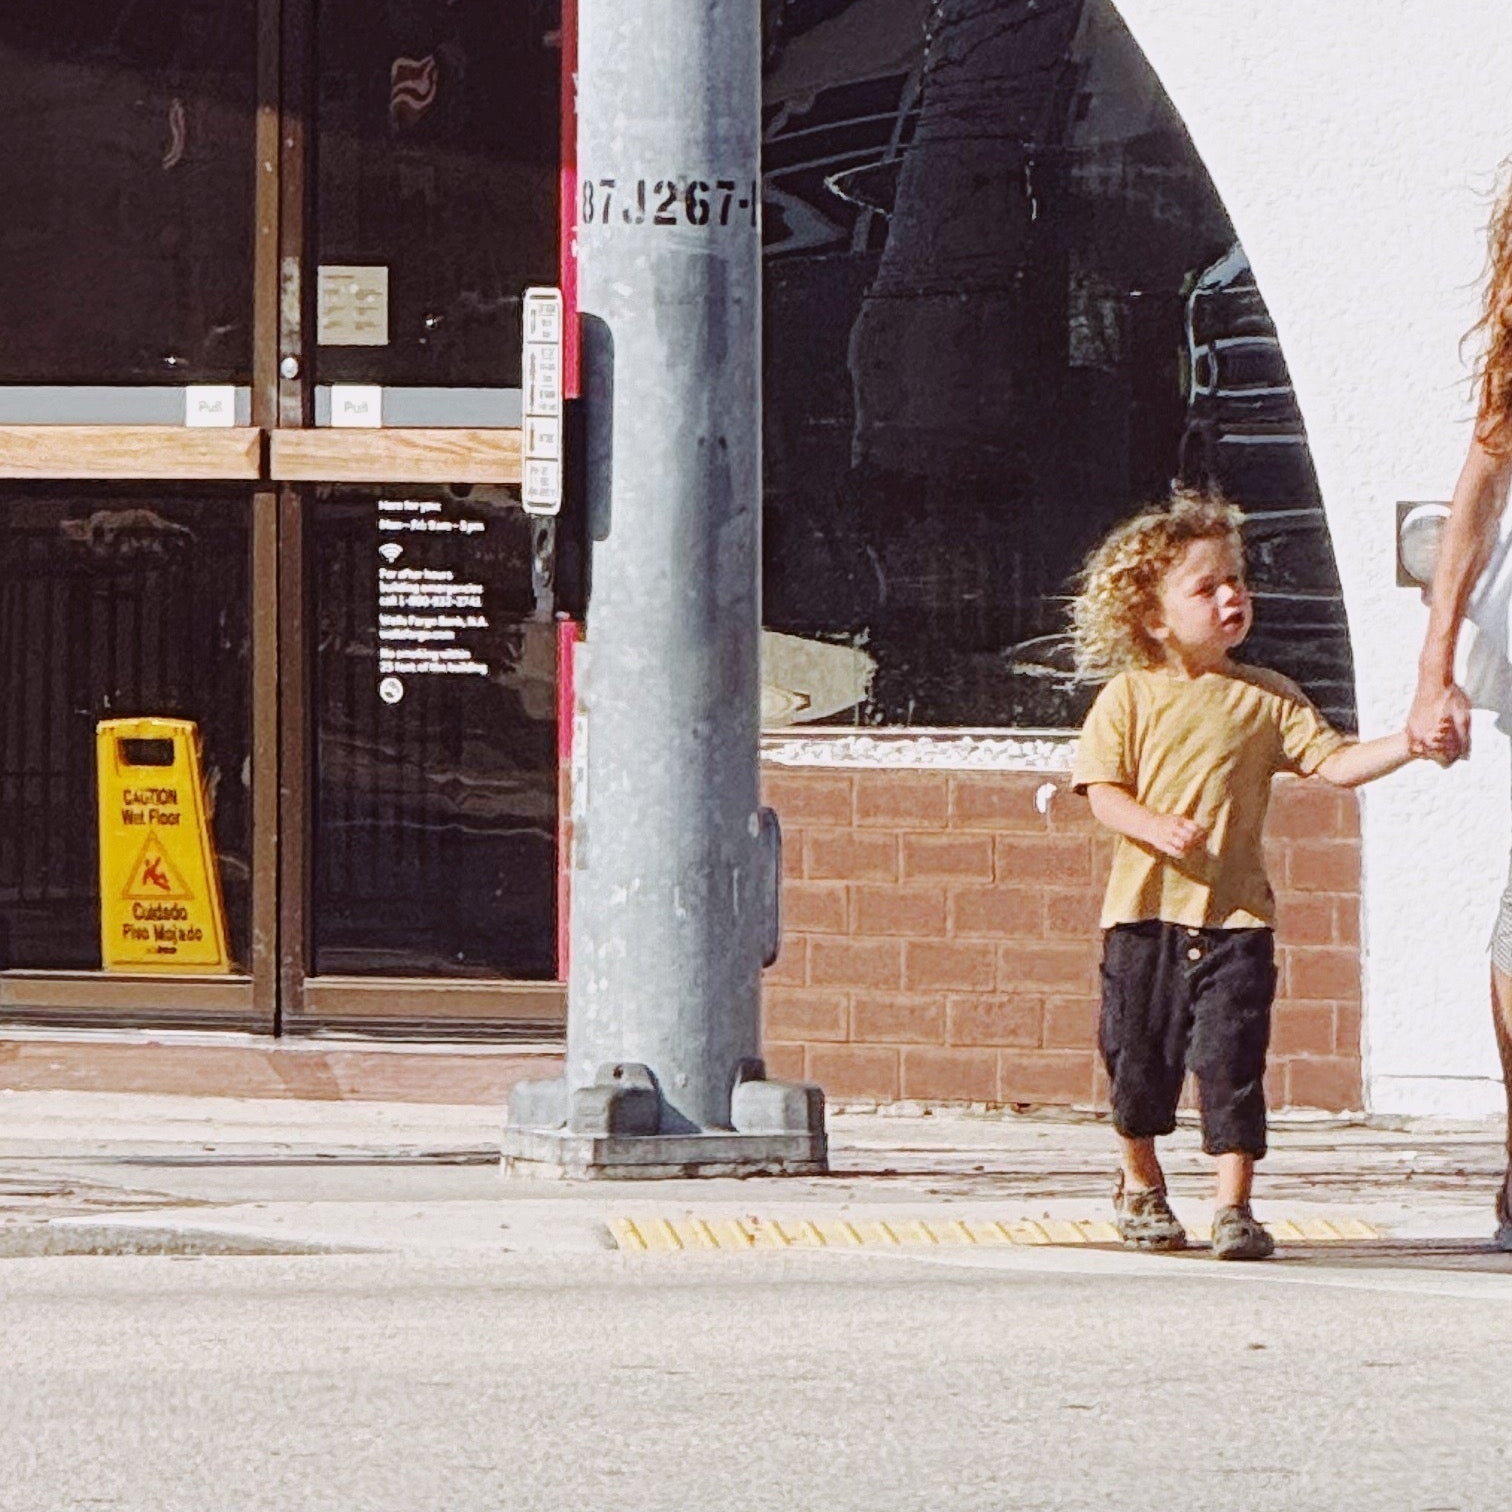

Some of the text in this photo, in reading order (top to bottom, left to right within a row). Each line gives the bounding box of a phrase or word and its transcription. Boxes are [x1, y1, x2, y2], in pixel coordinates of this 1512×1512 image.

[343, 399, 368, 414] Pull
[123, 788, 178, 806] CAUTION
[122, 808, 180, 826] Wet Floor
[132, 901, 188, 922] Cuidado
[122, 922, 203, 945] Piso Mojado
